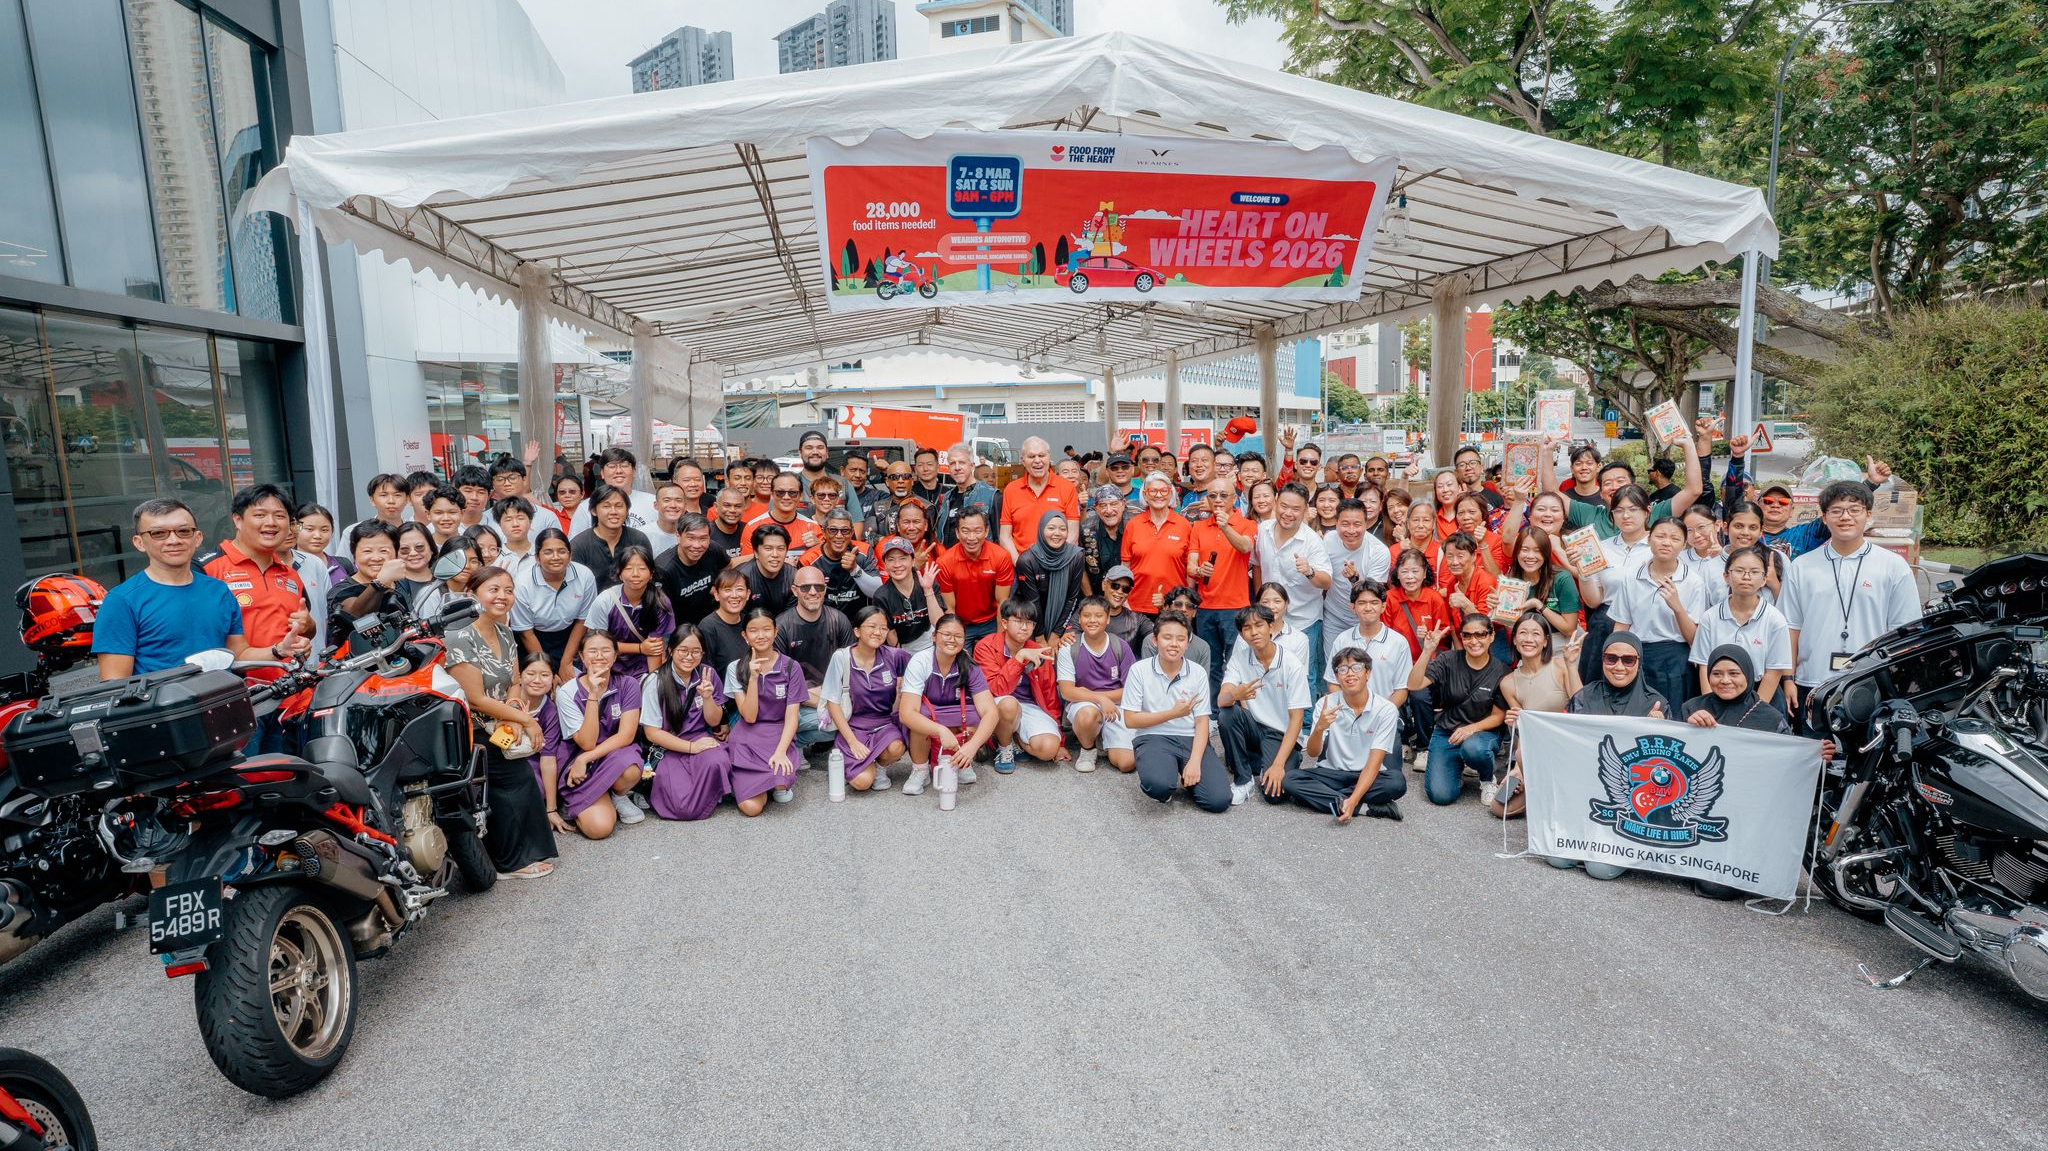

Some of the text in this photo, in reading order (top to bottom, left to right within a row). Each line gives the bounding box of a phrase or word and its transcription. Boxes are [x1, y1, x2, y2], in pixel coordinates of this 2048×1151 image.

[1069, 146, 1116, 156] FOOD FROM
[1069, 155, 1115, 164] THE HEART
[985, 167, 1011, 179] MAR
[956, 178, 1014, 191] SAT & SUN
[954, 190, 980, 202] 9AM
[990, 191, 1015, 202] 6PM
[1239, 194, 1281, 205] WELCOME TO
[866, 202, 921, 219] 28,000
[853, 218, 936, 231] food items needed!
[1178, 209, 1329, 239] HEART ON
[951, 235, 1026, 244] WEARNES AUTOMOTIVE
[1150, 237, 1346, 269] WHEELS 2026
[680, 575, 712, 597] DUCATI
[368, 686, 419, 698] DUCATI
[1622, 750, 1640, 763] BMW
[1642, 748, 1672, 757] RIDING
[1673, 751, 1699, 771] KAKIS
[1650, 786, 1672, 796] BMW
[1602, 809, 1614, 818] SG
[1624, 820, 1690, 840] MAKE LIFE A RIDE
[1697, 823, 1717, 832] 2021
[1556, 837, 1761, 884] BMW RIDING KAKIS SINGAPORE
[165, 889, 206, 918] FBX
